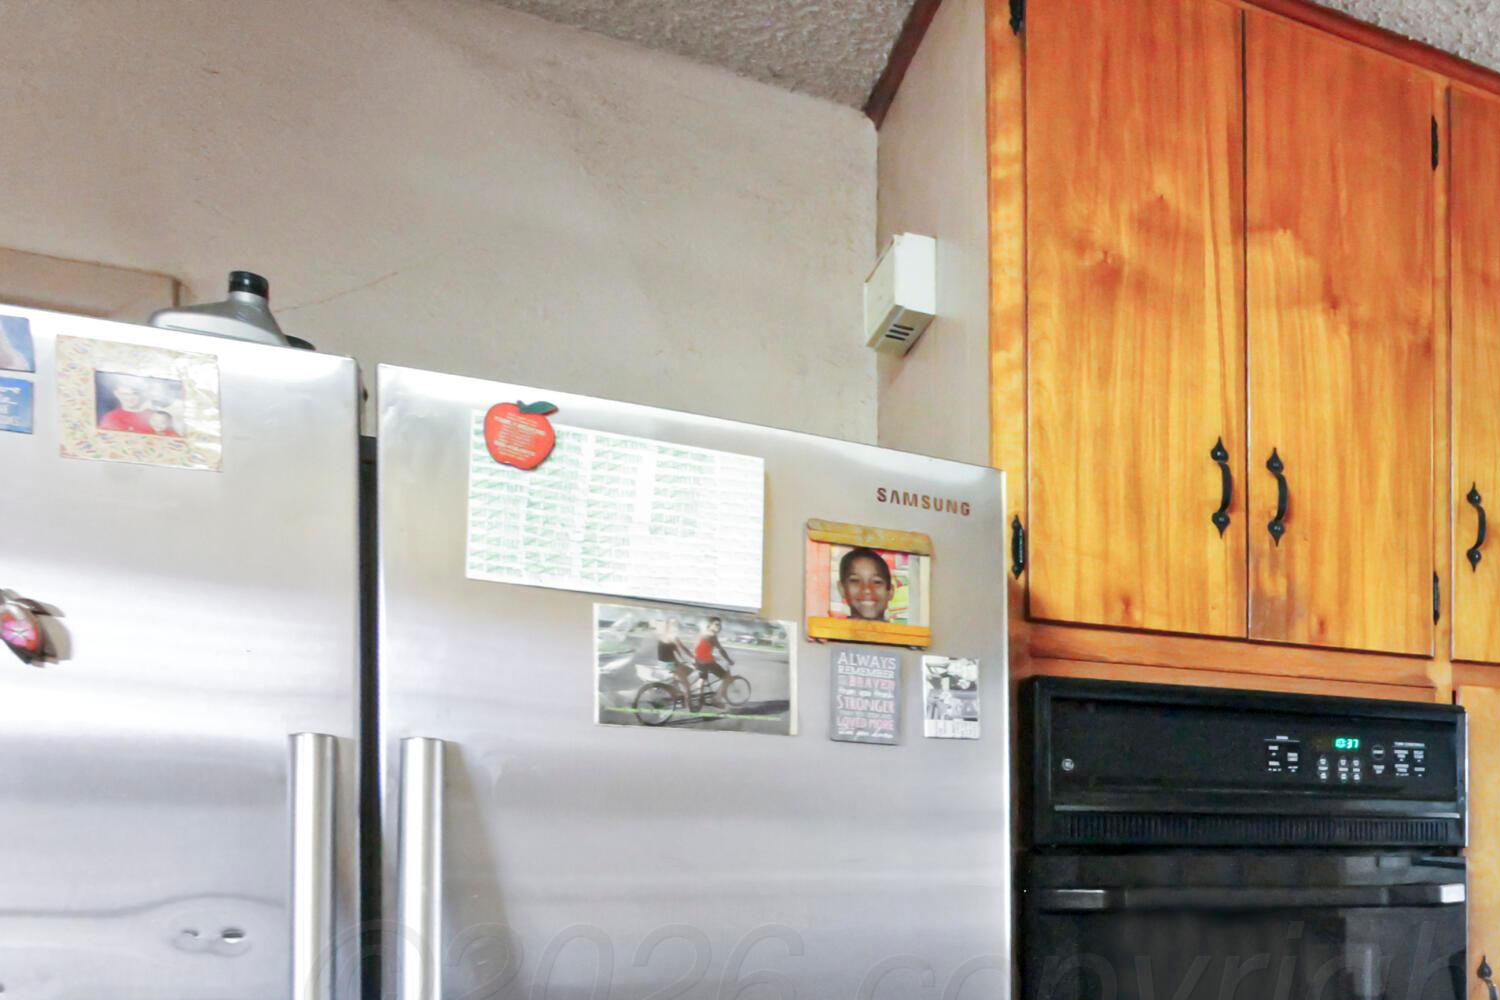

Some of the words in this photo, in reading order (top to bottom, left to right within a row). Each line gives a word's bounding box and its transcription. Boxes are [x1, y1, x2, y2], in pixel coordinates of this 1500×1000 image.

[876, 487, 971, 517] SAMSUNG
[837, 651, 897, 670] ALWAYS
[836, 695, 896, 714] STRONGER
